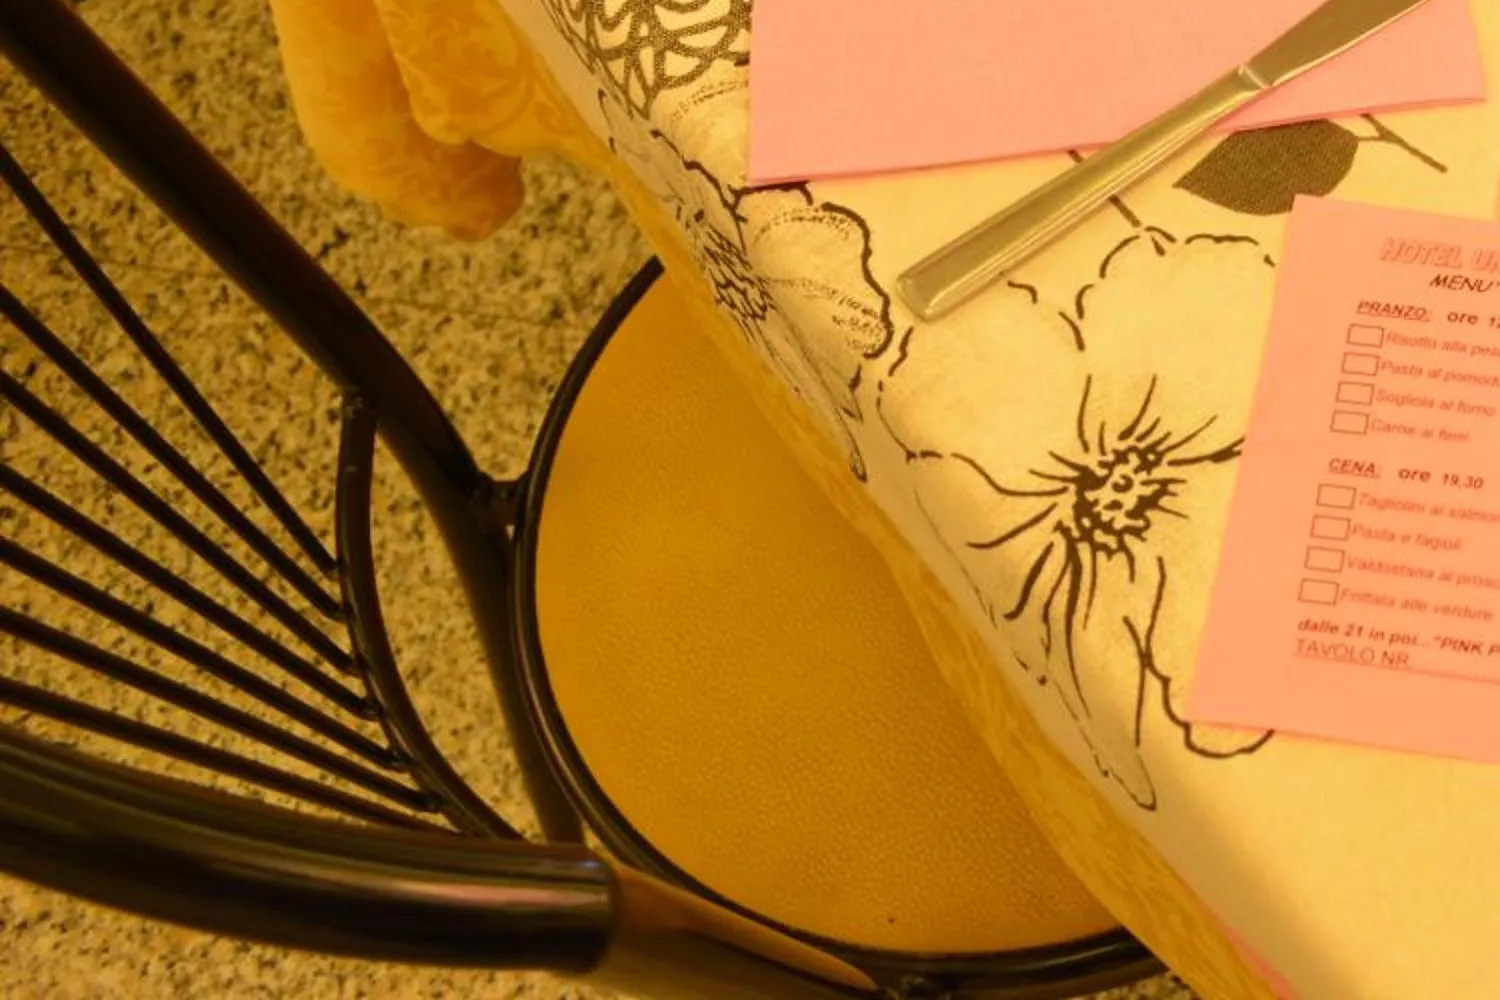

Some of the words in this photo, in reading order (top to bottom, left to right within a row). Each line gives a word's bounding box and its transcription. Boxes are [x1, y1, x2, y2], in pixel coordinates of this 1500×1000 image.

[1380, 236, 1462, 269] HOTEL
[1446, 311, 1479, 326] ore
[1440, 338, 1468, 353] alla
[1380, 359, 1423, 377] Pasta
[1398, 468, 1432, 483] ore
[1351, 522, 1396, 542] Pasta
[1400, 533, 1411, 545] e
[1431, 602, 1496, 622] verdure
[1298, 617, 1339, 635] dalle
[1344, 623, 1364, 639] 21
[1369, 627, 1385, 641] in
[1296, 637, 1376, 666] TAVOLO
